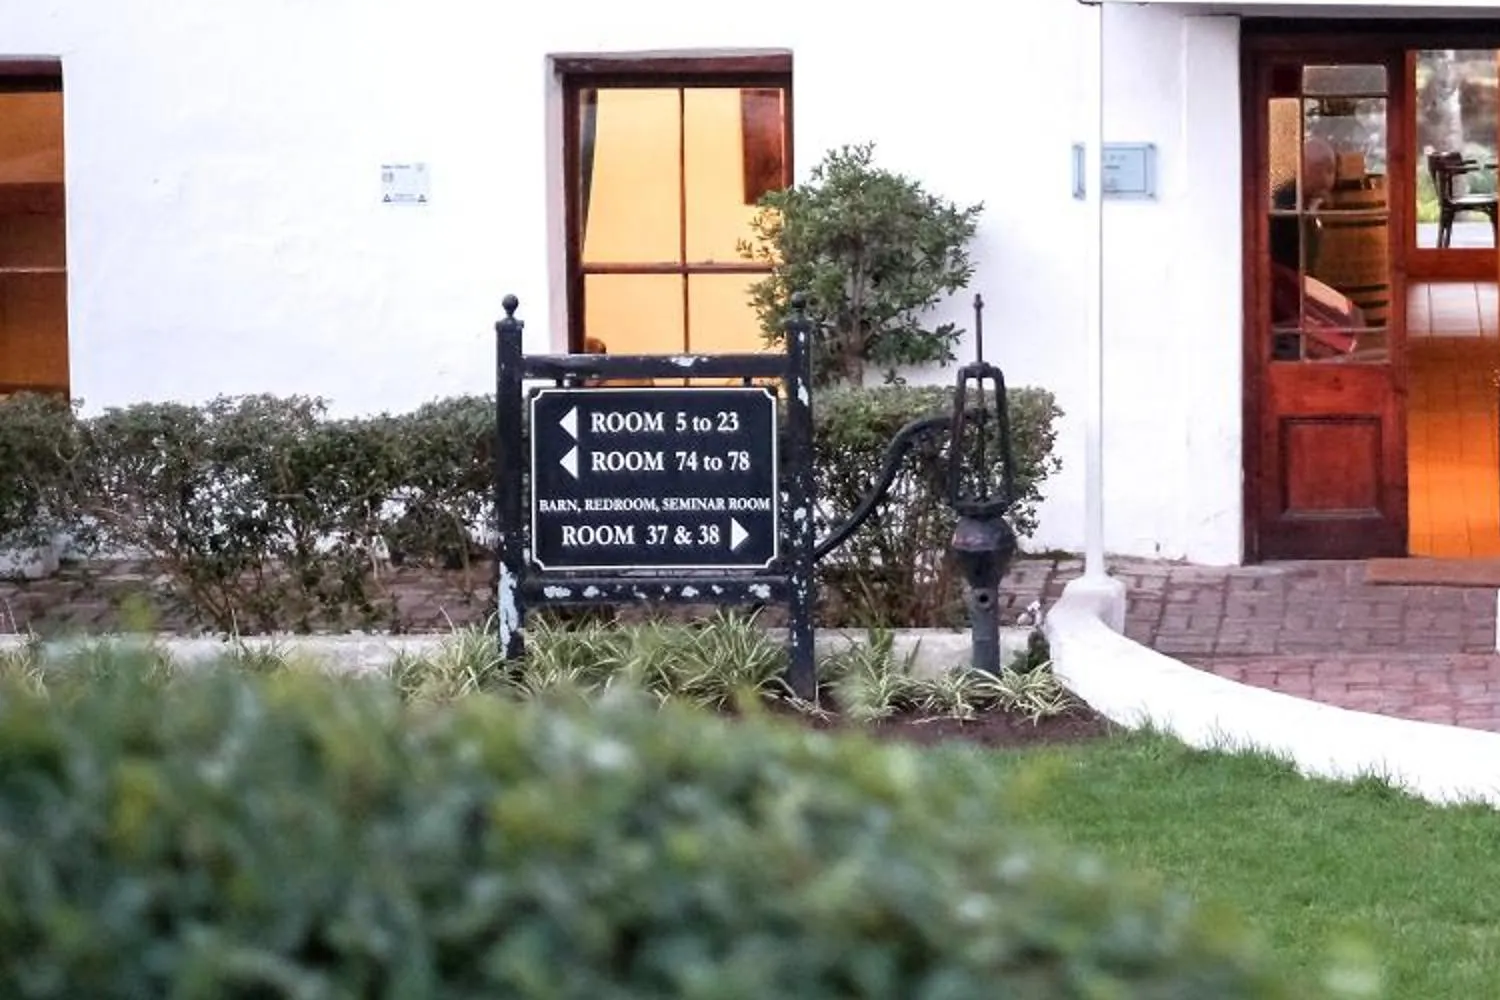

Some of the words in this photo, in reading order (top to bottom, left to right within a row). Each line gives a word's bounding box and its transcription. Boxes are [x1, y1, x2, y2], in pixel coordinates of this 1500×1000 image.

[591, 411, 664, 433] ROOM
[676, 411, 688, 433] 5
[692, 413, 712, 433] to
[717, 411, 739, 432] 23
[591, 450, 664, 472] ROOM
[676, 450, 699, 472] 74
[703, 453, 723, 472] to
[728, 450, 751, 471] 78
[539, 498, 582, 513] BARN,
[661, 497, 726, 511] SEMINAR
[728, 497, 771, 511] ROOM
[561, 525, 635, 546] ROOM
[646, 525, 668, 545] 37
[673, 525, 693, 546] &
[698, 524, 720, 545] 38
